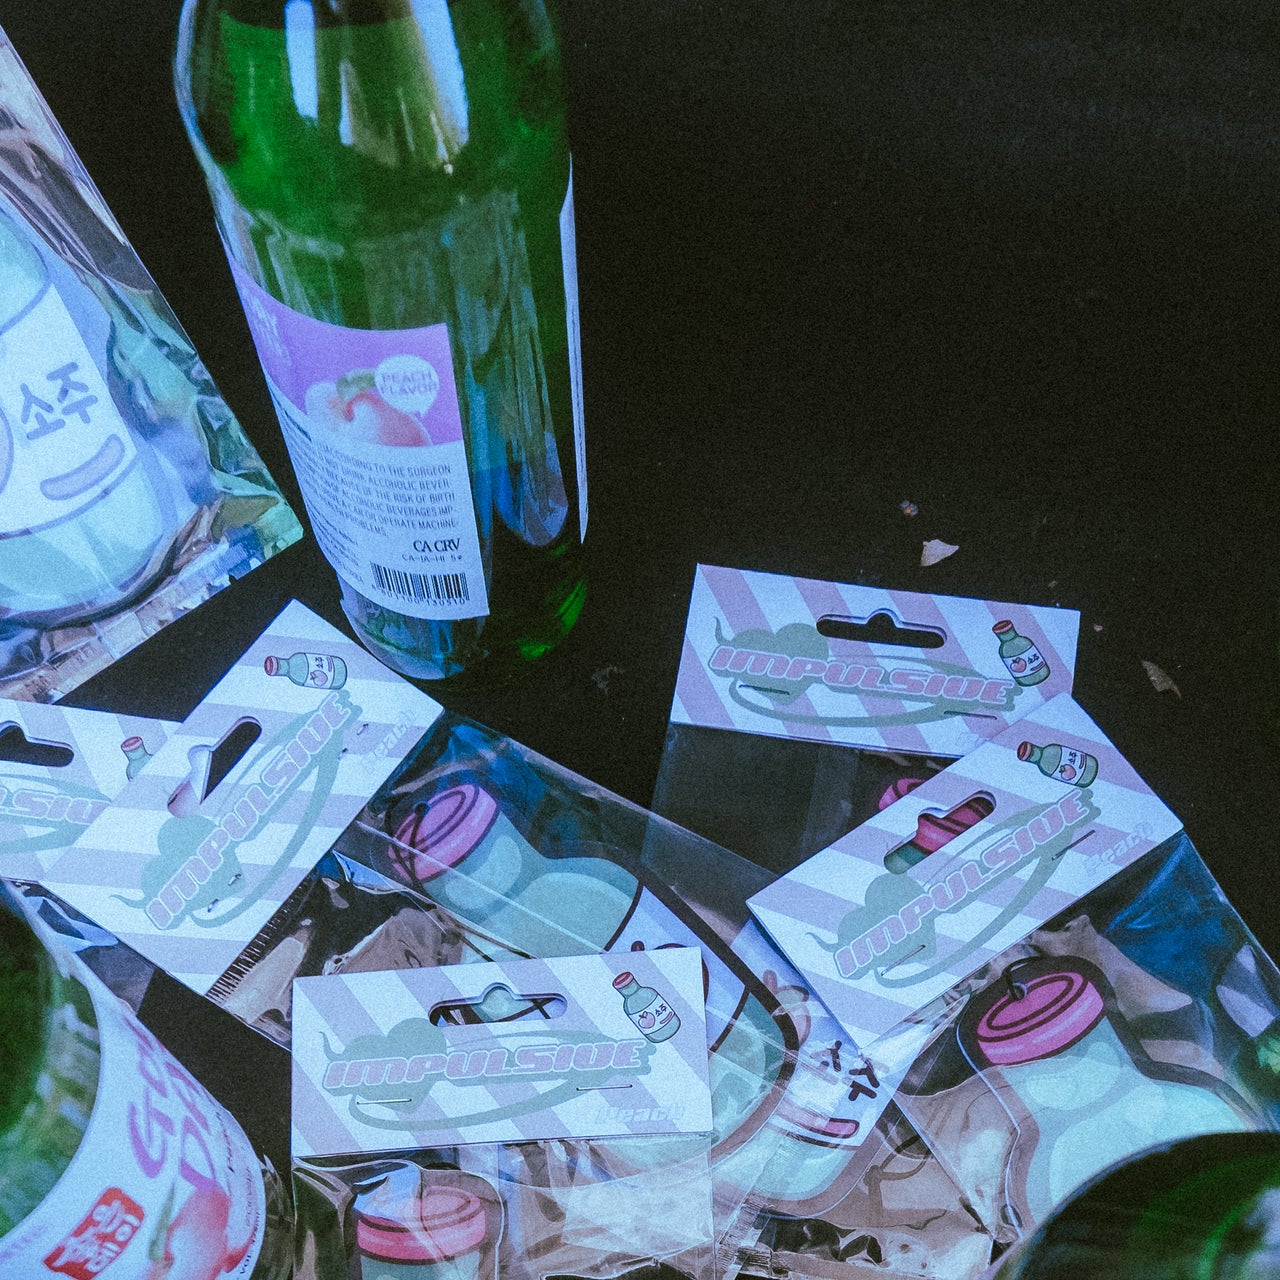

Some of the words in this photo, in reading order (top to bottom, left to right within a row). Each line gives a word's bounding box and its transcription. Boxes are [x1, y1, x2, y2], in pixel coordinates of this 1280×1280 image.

[19, 361, 103, 443] 소주
[413, 540, 432, 552] CA
[434, 538, 460, 551] CRV
